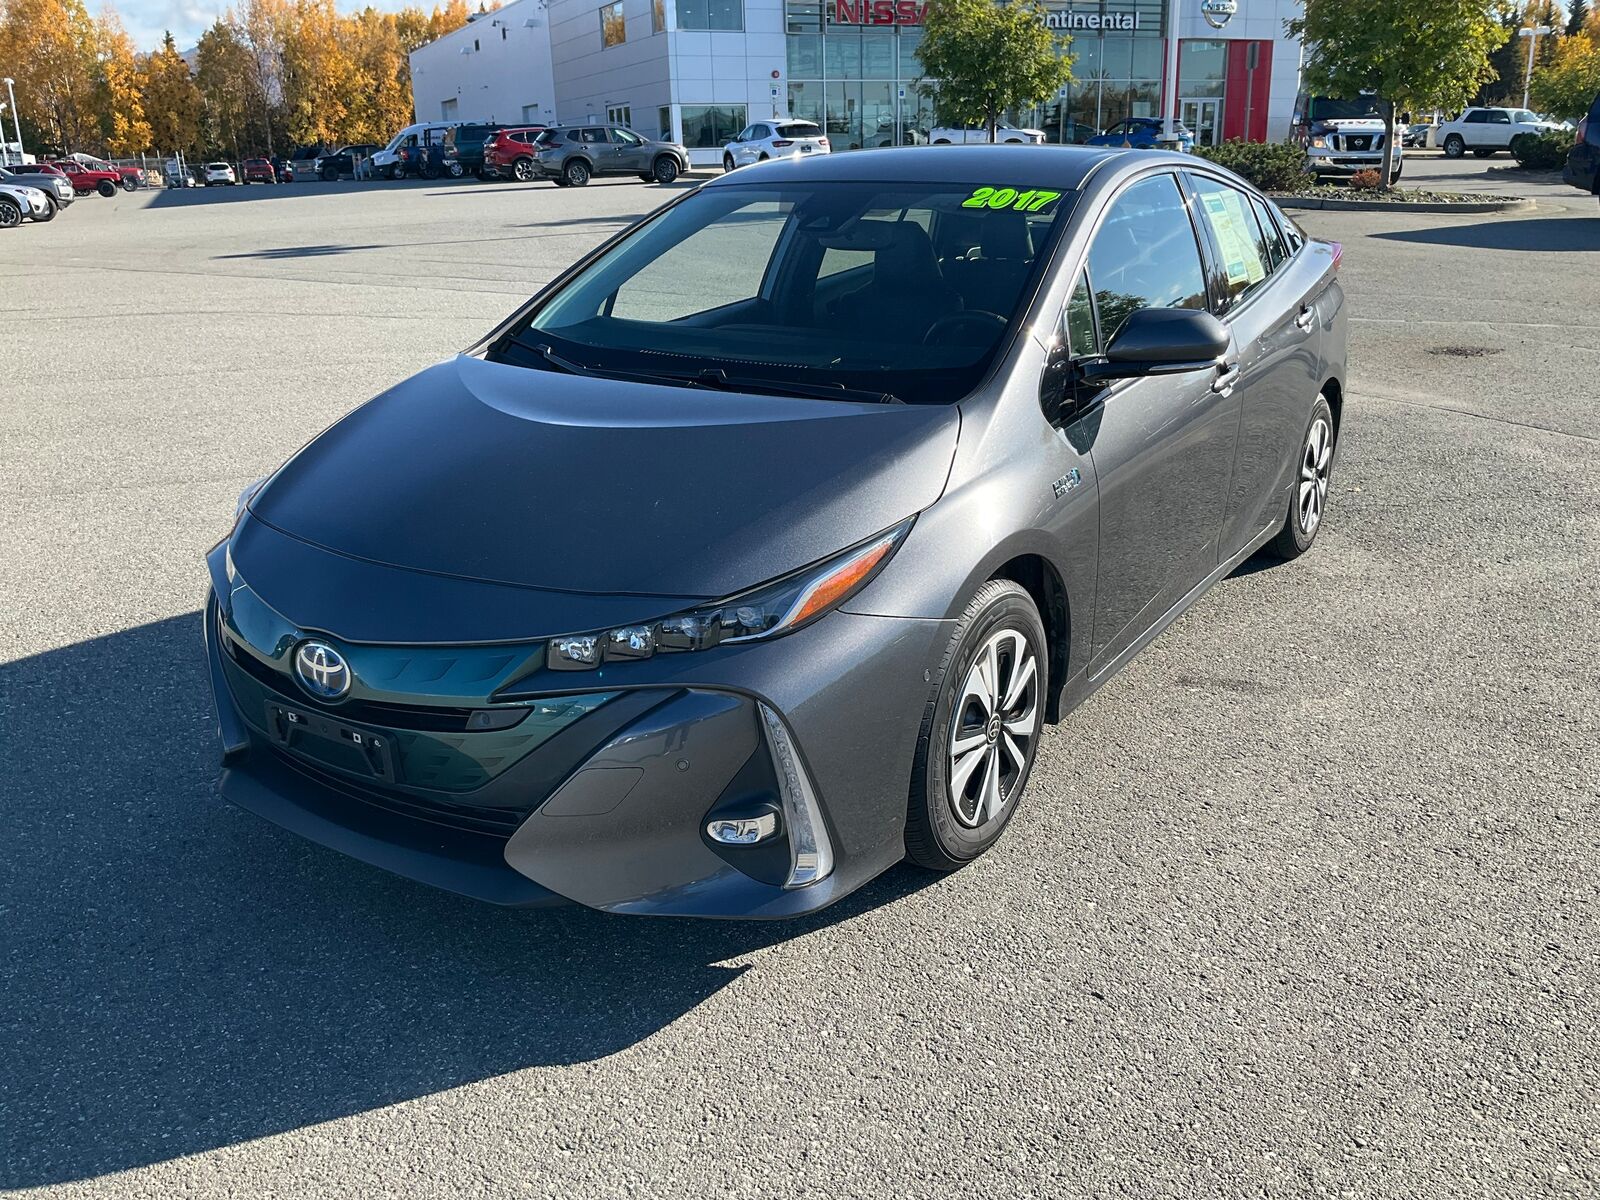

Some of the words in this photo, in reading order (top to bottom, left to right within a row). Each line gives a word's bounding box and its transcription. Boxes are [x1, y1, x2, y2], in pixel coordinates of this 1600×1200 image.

[835, 0, 930, 24] NISS
[1206, 3, 1236, 11] NISSAN
[1032, 10, 1140, 29] ontinental
[962, 187, 1061, 212] 2017
